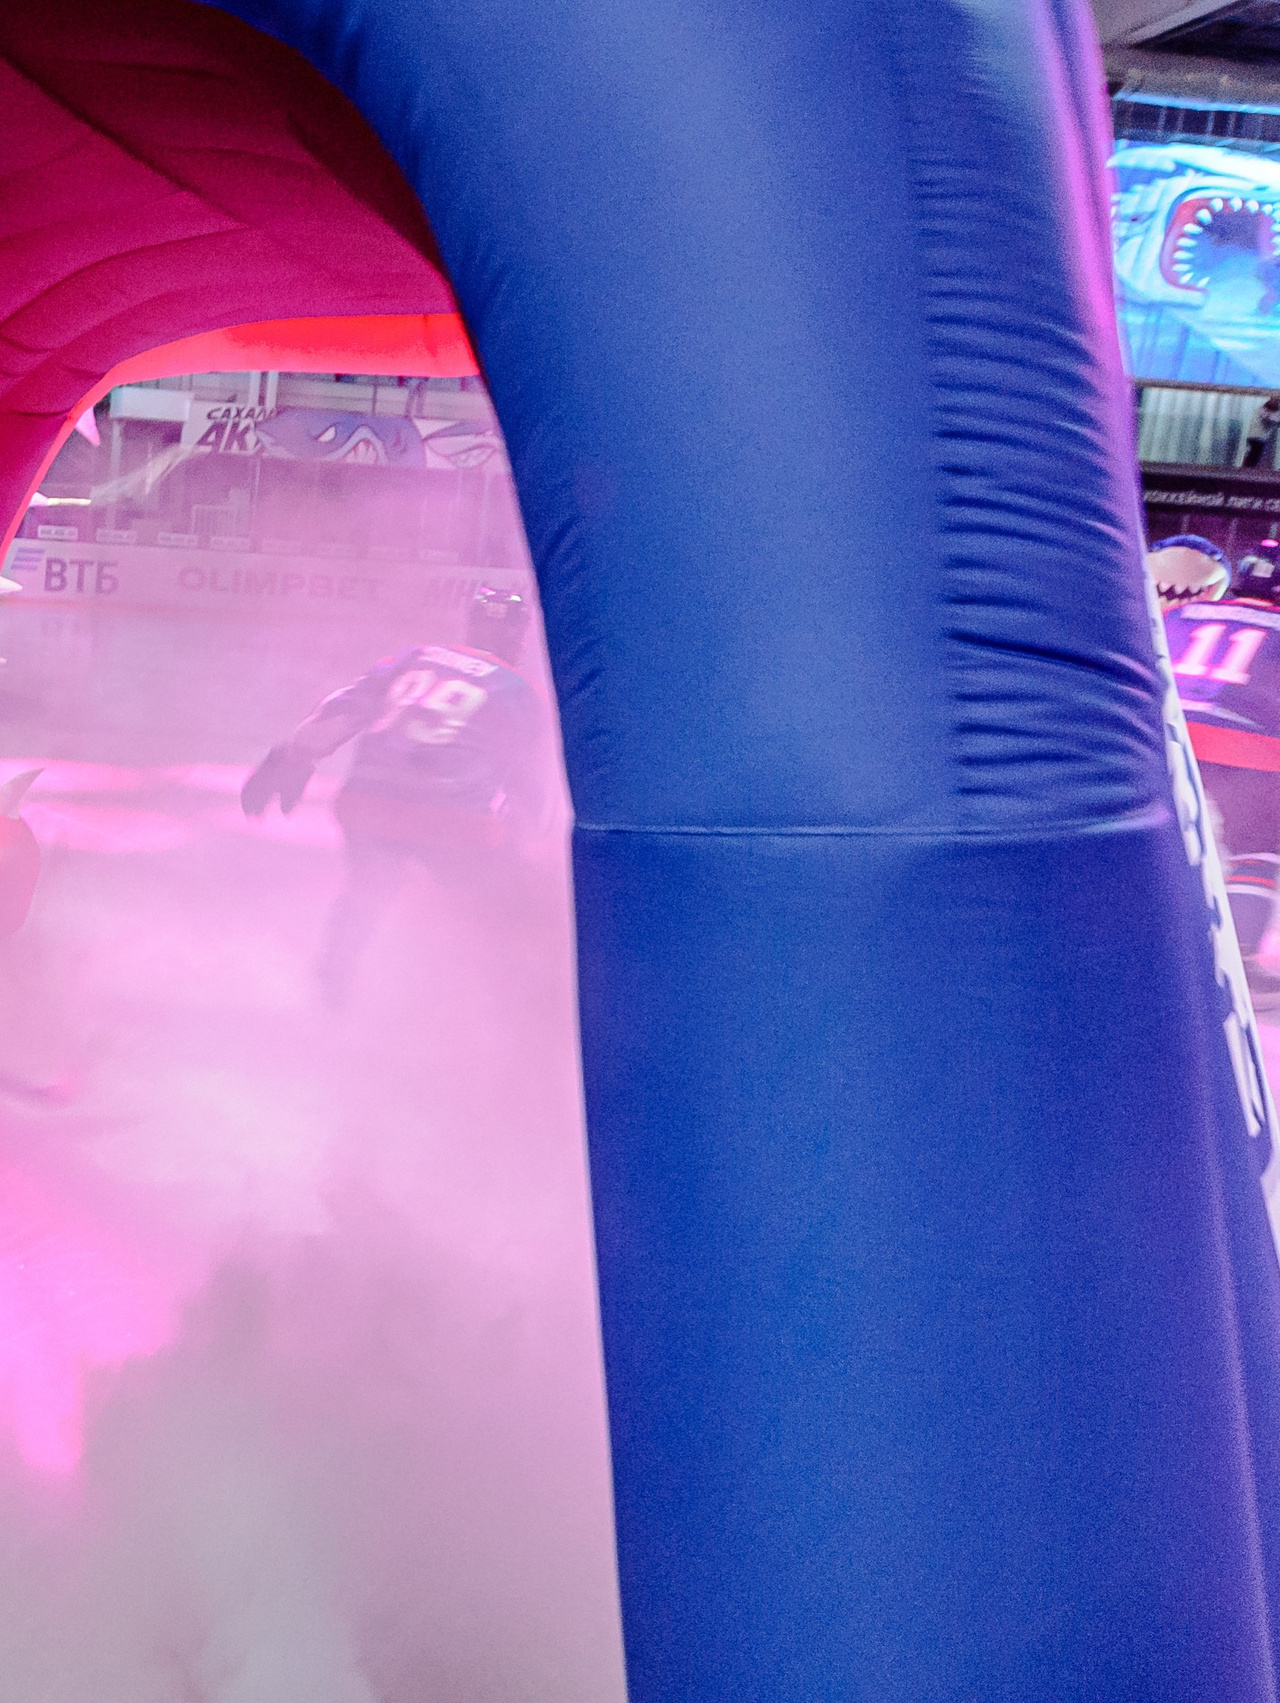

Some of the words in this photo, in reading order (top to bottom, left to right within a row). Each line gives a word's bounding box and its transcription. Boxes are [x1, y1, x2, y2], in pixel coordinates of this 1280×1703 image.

[43, 557, 120, 595] ВТБ
[177, 566, 385, 601] OLIMPBET
[1172, 622, 1269, 686] 11
